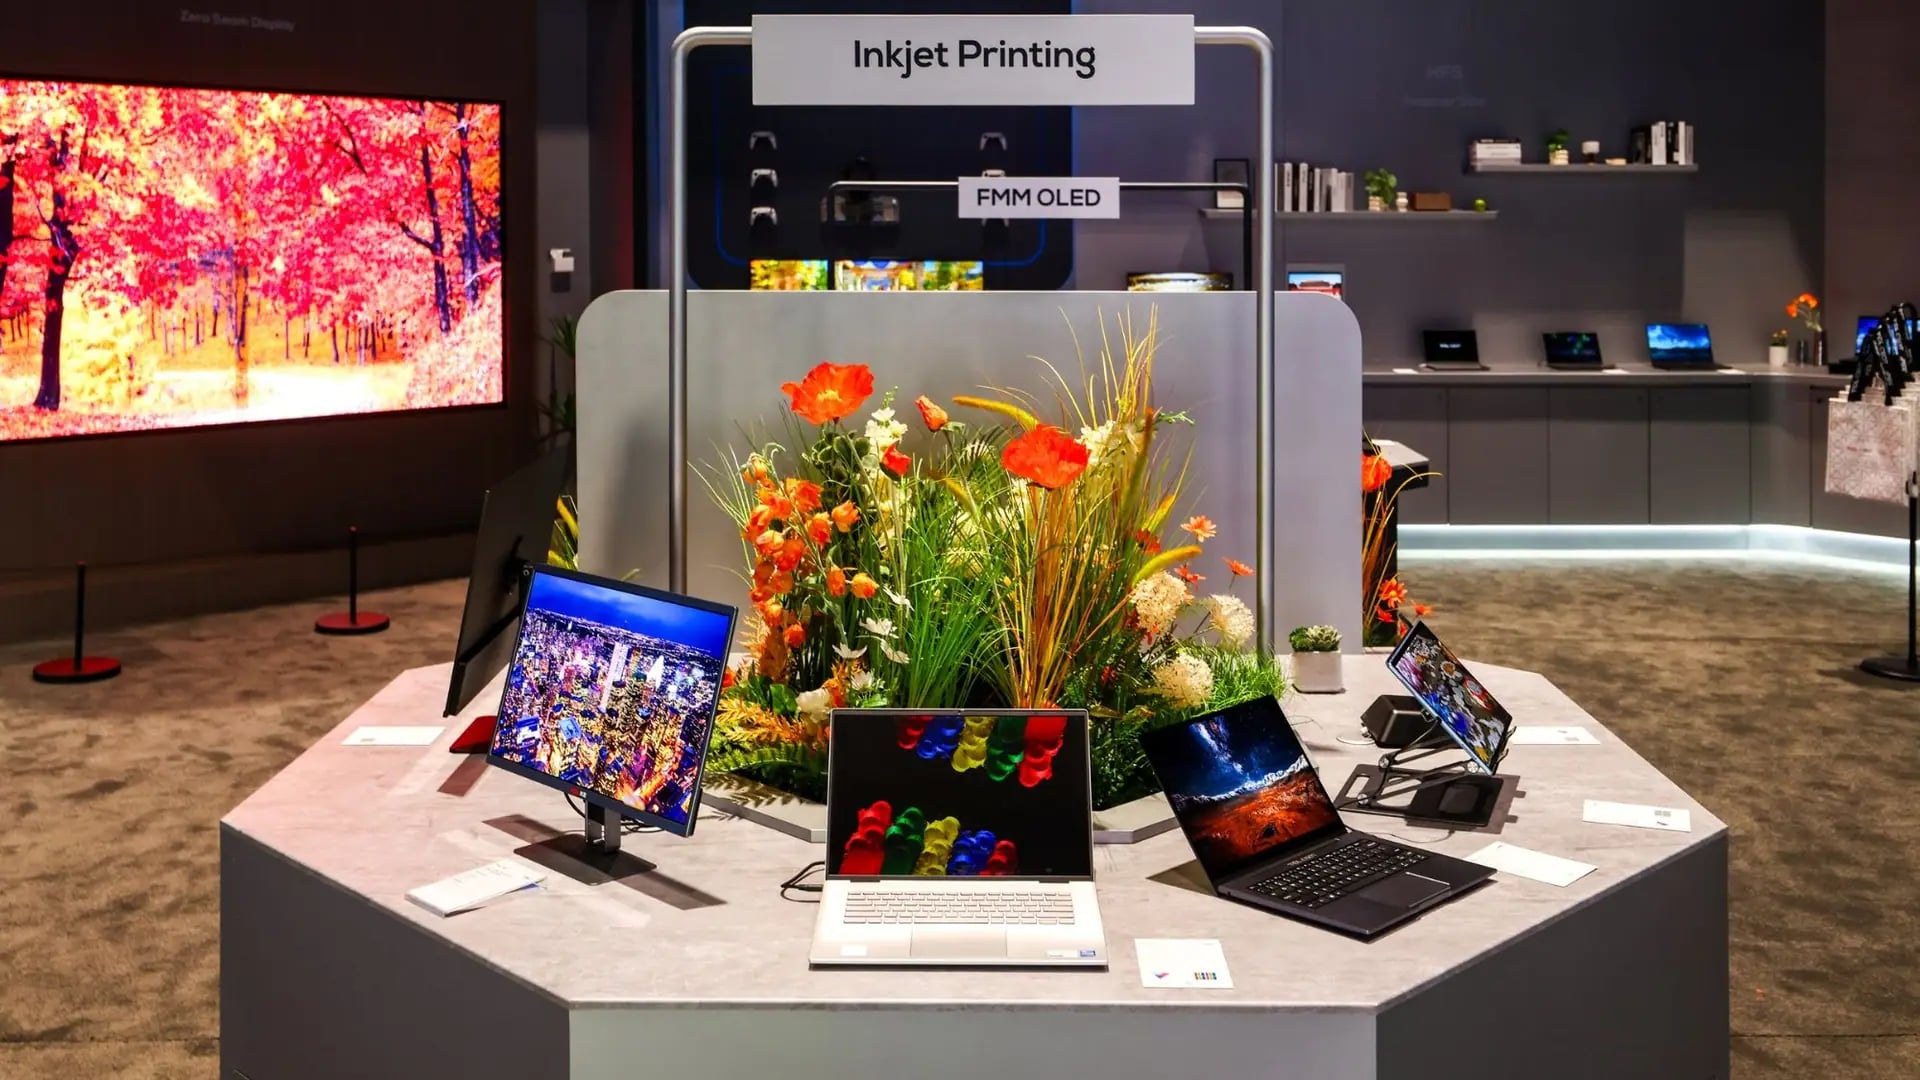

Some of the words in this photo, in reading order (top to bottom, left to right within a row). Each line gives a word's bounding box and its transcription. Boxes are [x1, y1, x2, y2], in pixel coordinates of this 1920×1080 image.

[251, 16, 297, 32] Display
[854, 39, 950, 79] Inkjet
[958, 39, 1096, 79] Printing
[976, 188, 1031, 206] FMM
[1037, 188, 1101, 206] OLED
